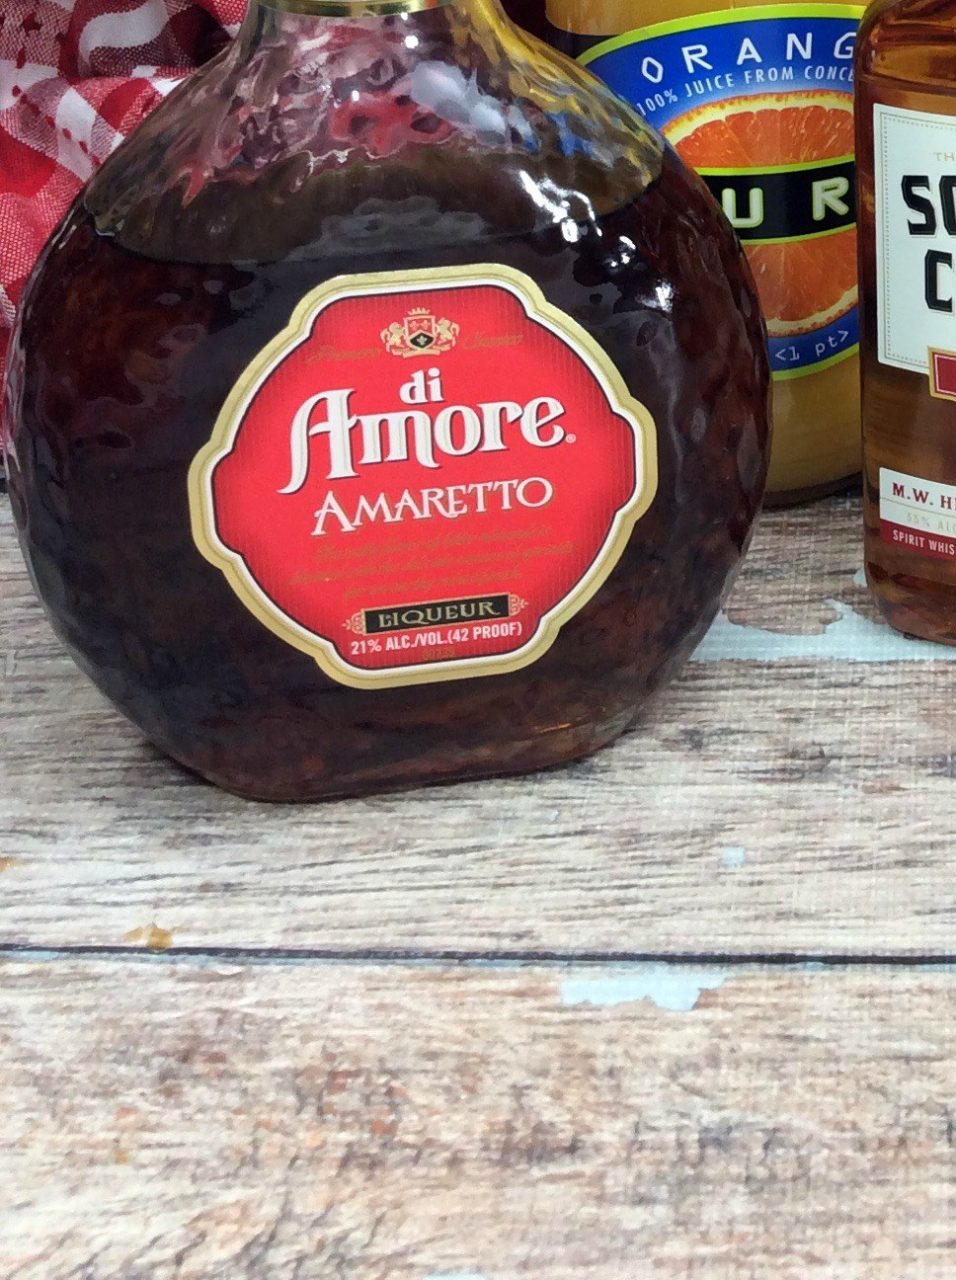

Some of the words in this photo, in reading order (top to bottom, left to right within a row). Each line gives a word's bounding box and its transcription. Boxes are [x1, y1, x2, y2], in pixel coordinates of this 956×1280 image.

[641, 31, 857, 84] ORANG
[636, 88, 678, 116] 100%
[685, 73, 734, 98] JUICE
[744, 66, 794, 84] FROM
[804, 65, 854, 83] CONCE
[721, 176, 849, 228] UR
[399, 367, 443, 405] di
[277, 387, 566, 495] Amore
[310, 476, 554, 537] AMARETTO
[892, 482, 935, 506] M.W.
[892, 529, 925, 548] SPIRIT
[378, 601, 501, 628] LIQUEUR
[351, 639, 382, 655] 21%
[473, 621, 523, 640] PROOF)
